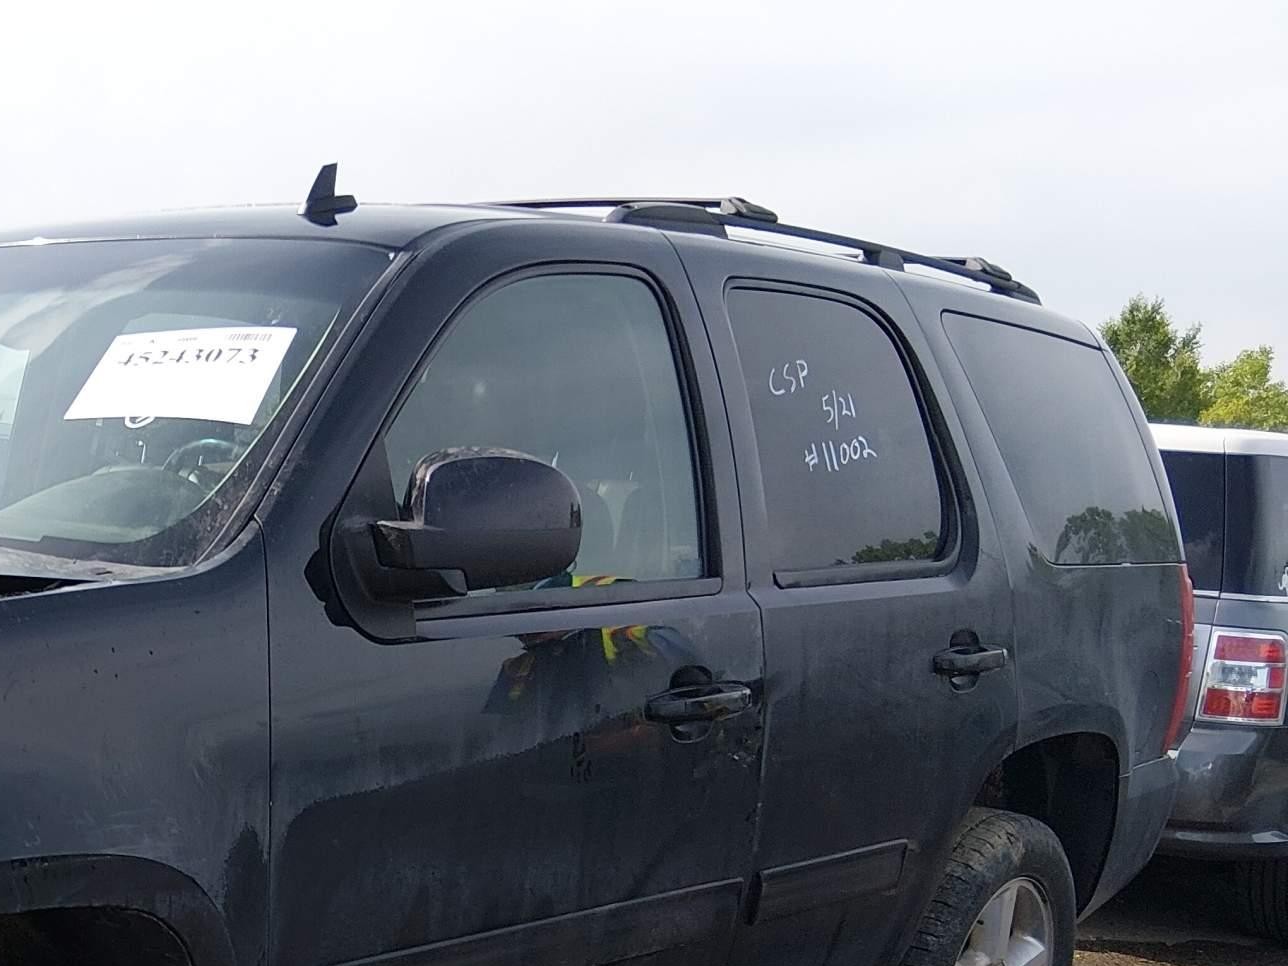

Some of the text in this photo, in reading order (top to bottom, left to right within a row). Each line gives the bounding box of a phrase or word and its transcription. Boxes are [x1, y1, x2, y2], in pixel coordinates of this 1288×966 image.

[117, 348, 259, 367] 45243073
[768, 359, 809, 395] CSP
[821, 389, 857, 431] 5/21
[804, 436, 878, 472] #11002
